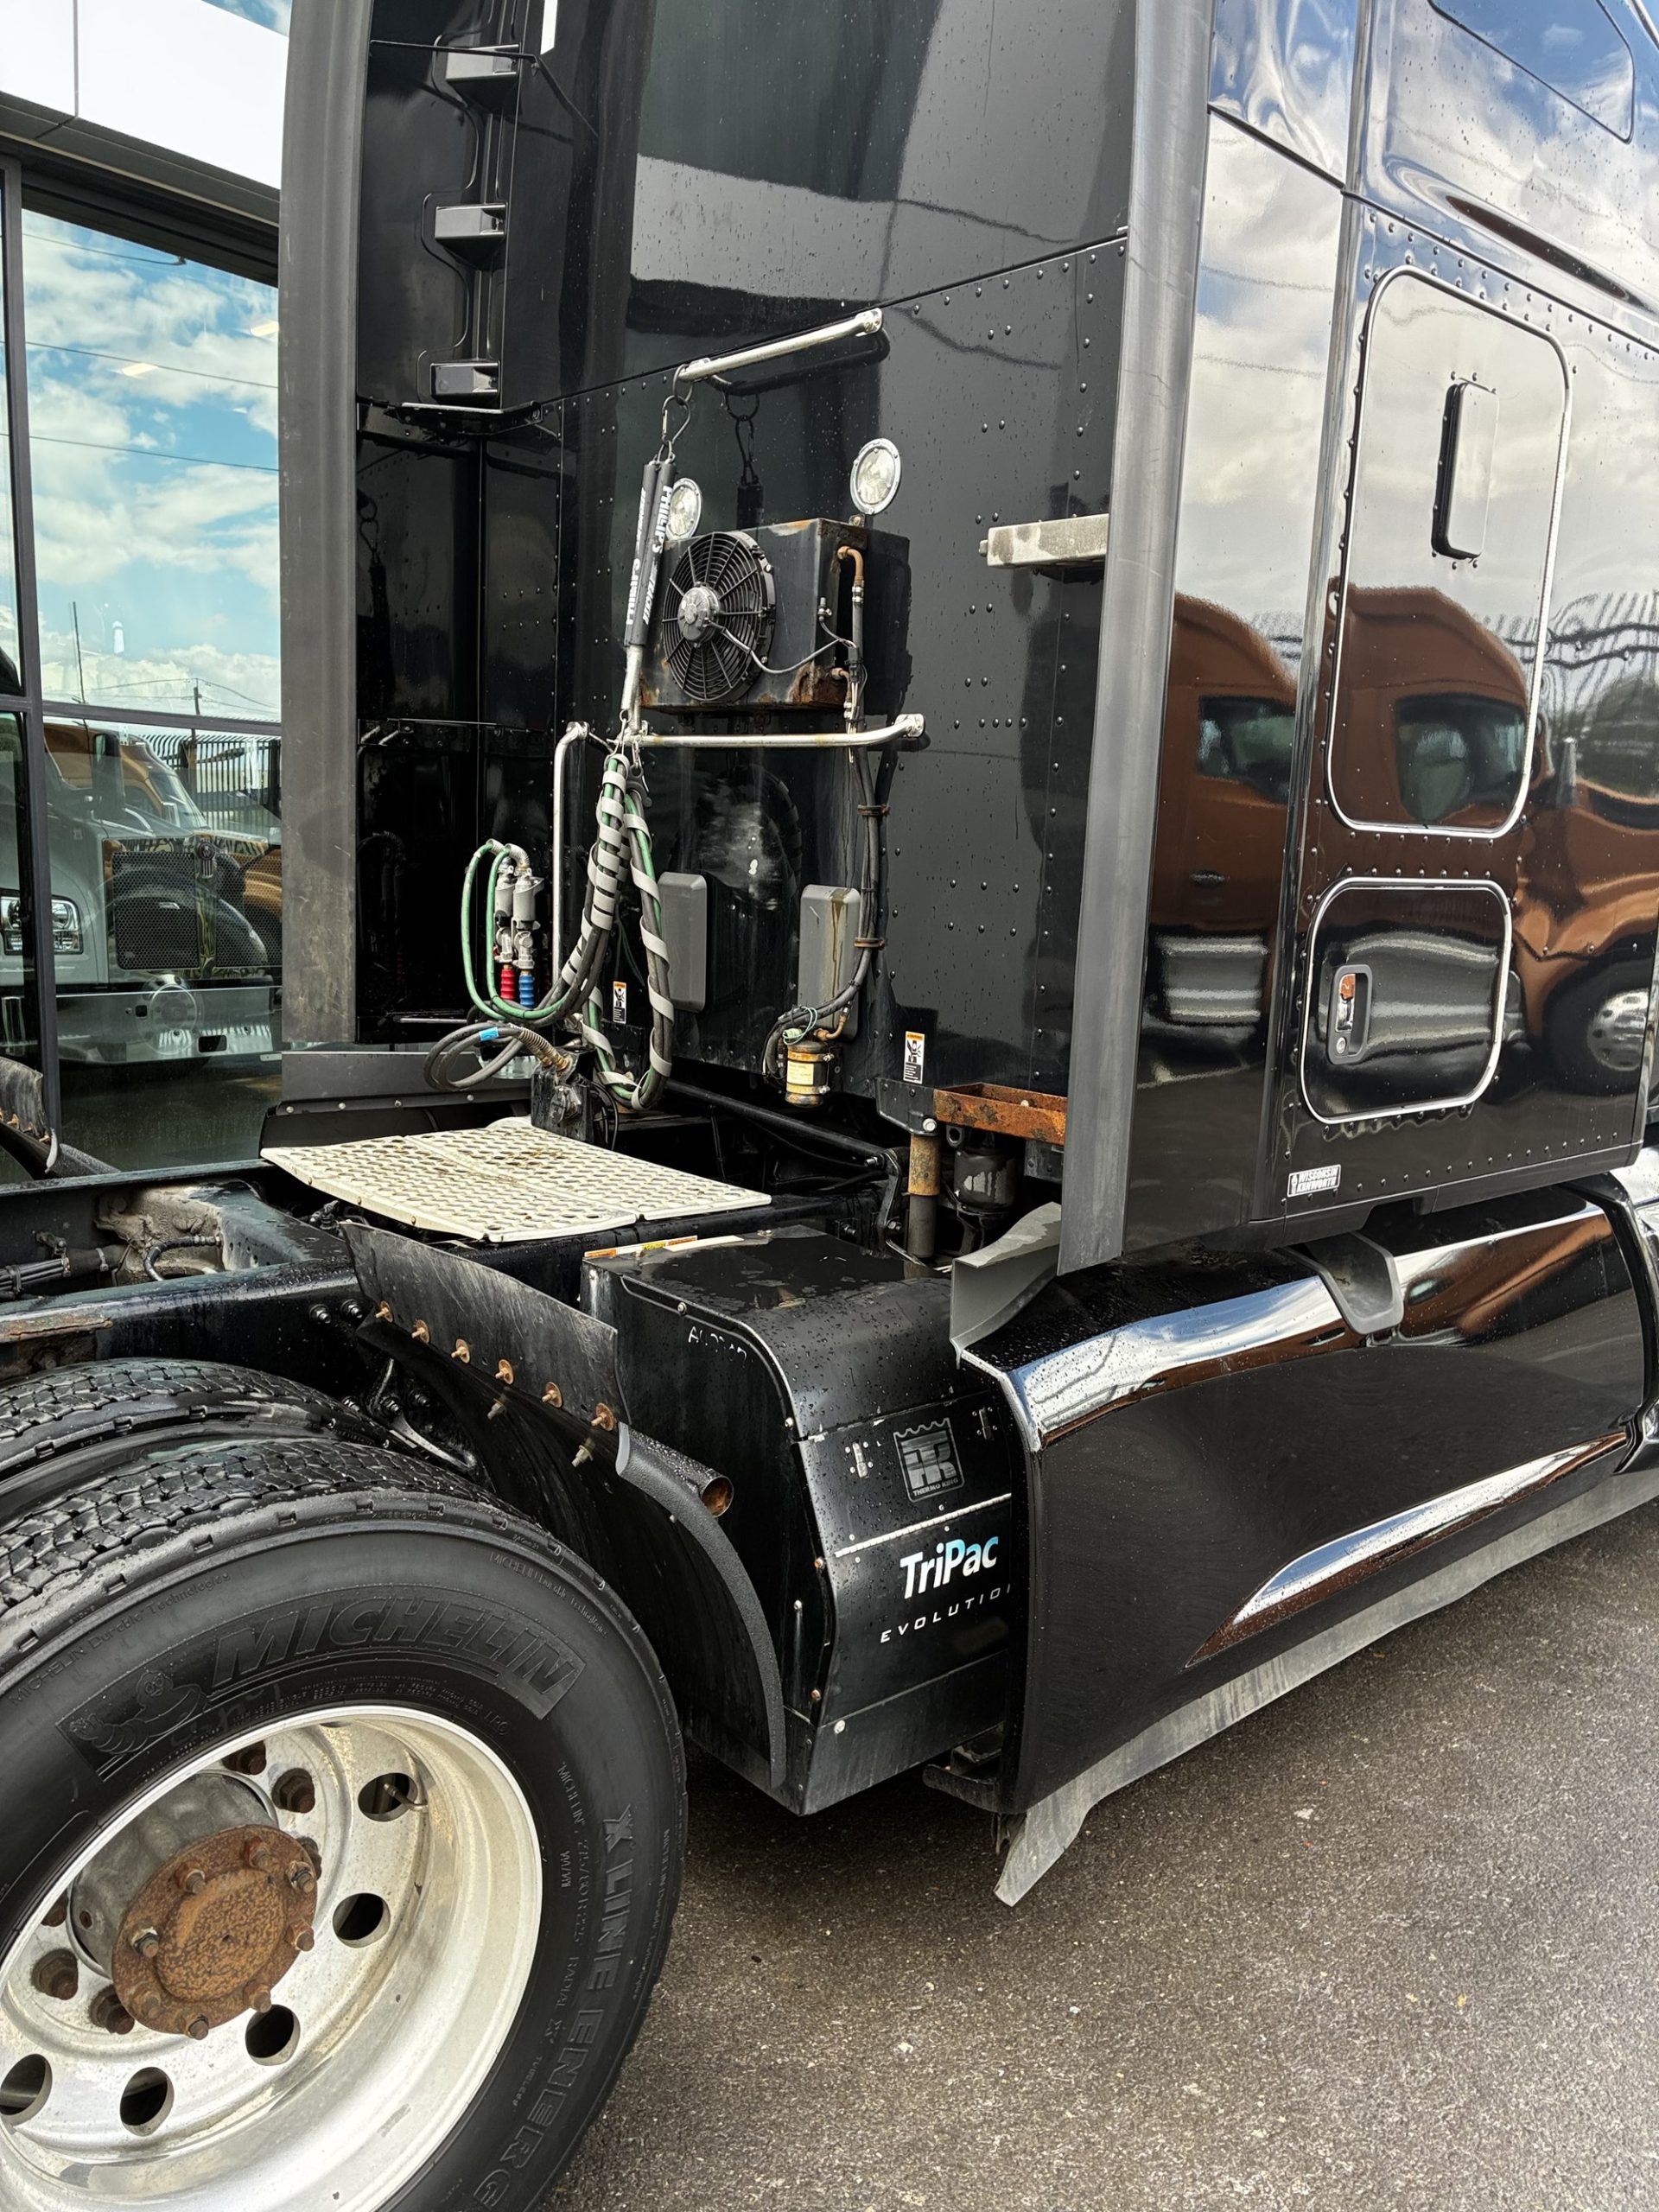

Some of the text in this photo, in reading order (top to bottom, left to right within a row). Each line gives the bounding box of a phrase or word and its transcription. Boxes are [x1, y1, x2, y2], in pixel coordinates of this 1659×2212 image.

[652, 486, 673, 554] PHILLIPS
[1296, 1176, 1337, 1193] KENWORTH
[1298, 1167, 1338, 1185] WISCONSIN
[912, 1477, 959, 1497] THERMO KING
[899, 1536, 999, 1599] TriPac
[9, 1649, 86, 1707] MICHELIN
[148, 1572, 231, 1616] Technologies
[880, 1583, 1011, 1643] EVOLUTIO
[212, 1597, 576, 1694] MICHELIN
[587, 1859, 634, 1991] LINE
